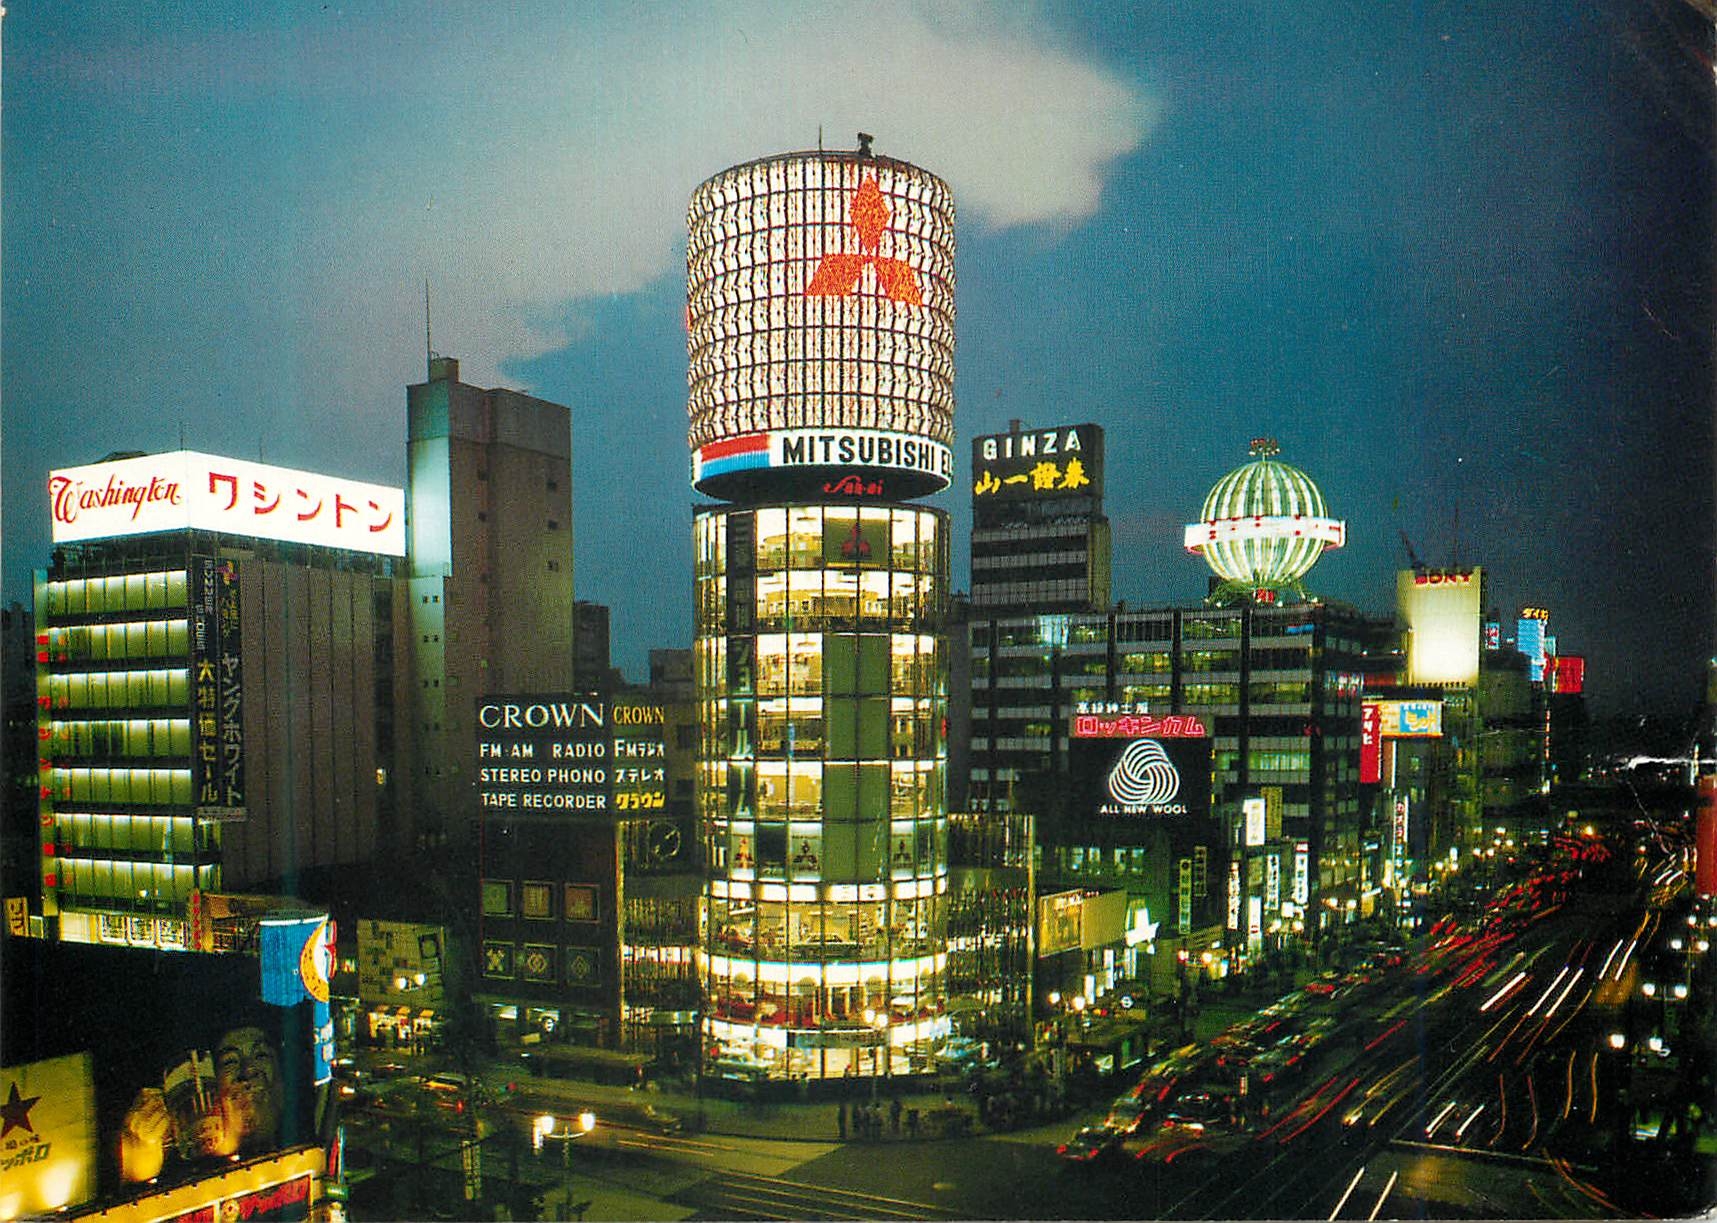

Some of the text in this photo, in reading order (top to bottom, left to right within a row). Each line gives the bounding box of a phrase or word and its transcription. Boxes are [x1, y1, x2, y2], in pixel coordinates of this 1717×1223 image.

[783, 435, 935, 472] MITSUBISHI
[983, 430, 1081, 460] GINZA
[48, 473, 181, 523] Washington
[209, 472, 392, 532] ワシントン
[480, 703, 604, 728] CROWN
[613, 705, 664, 725] CROWN
[553, 743, 605, 758] RADIO
[480, 768, 605, 783] STEREO PHONO
[615, 768, 664, 783] ステレオ
[481, 793, 606, 809] TAPE RECORDER
[1101, 805, 1187, 814] ALL NEW WOOL
